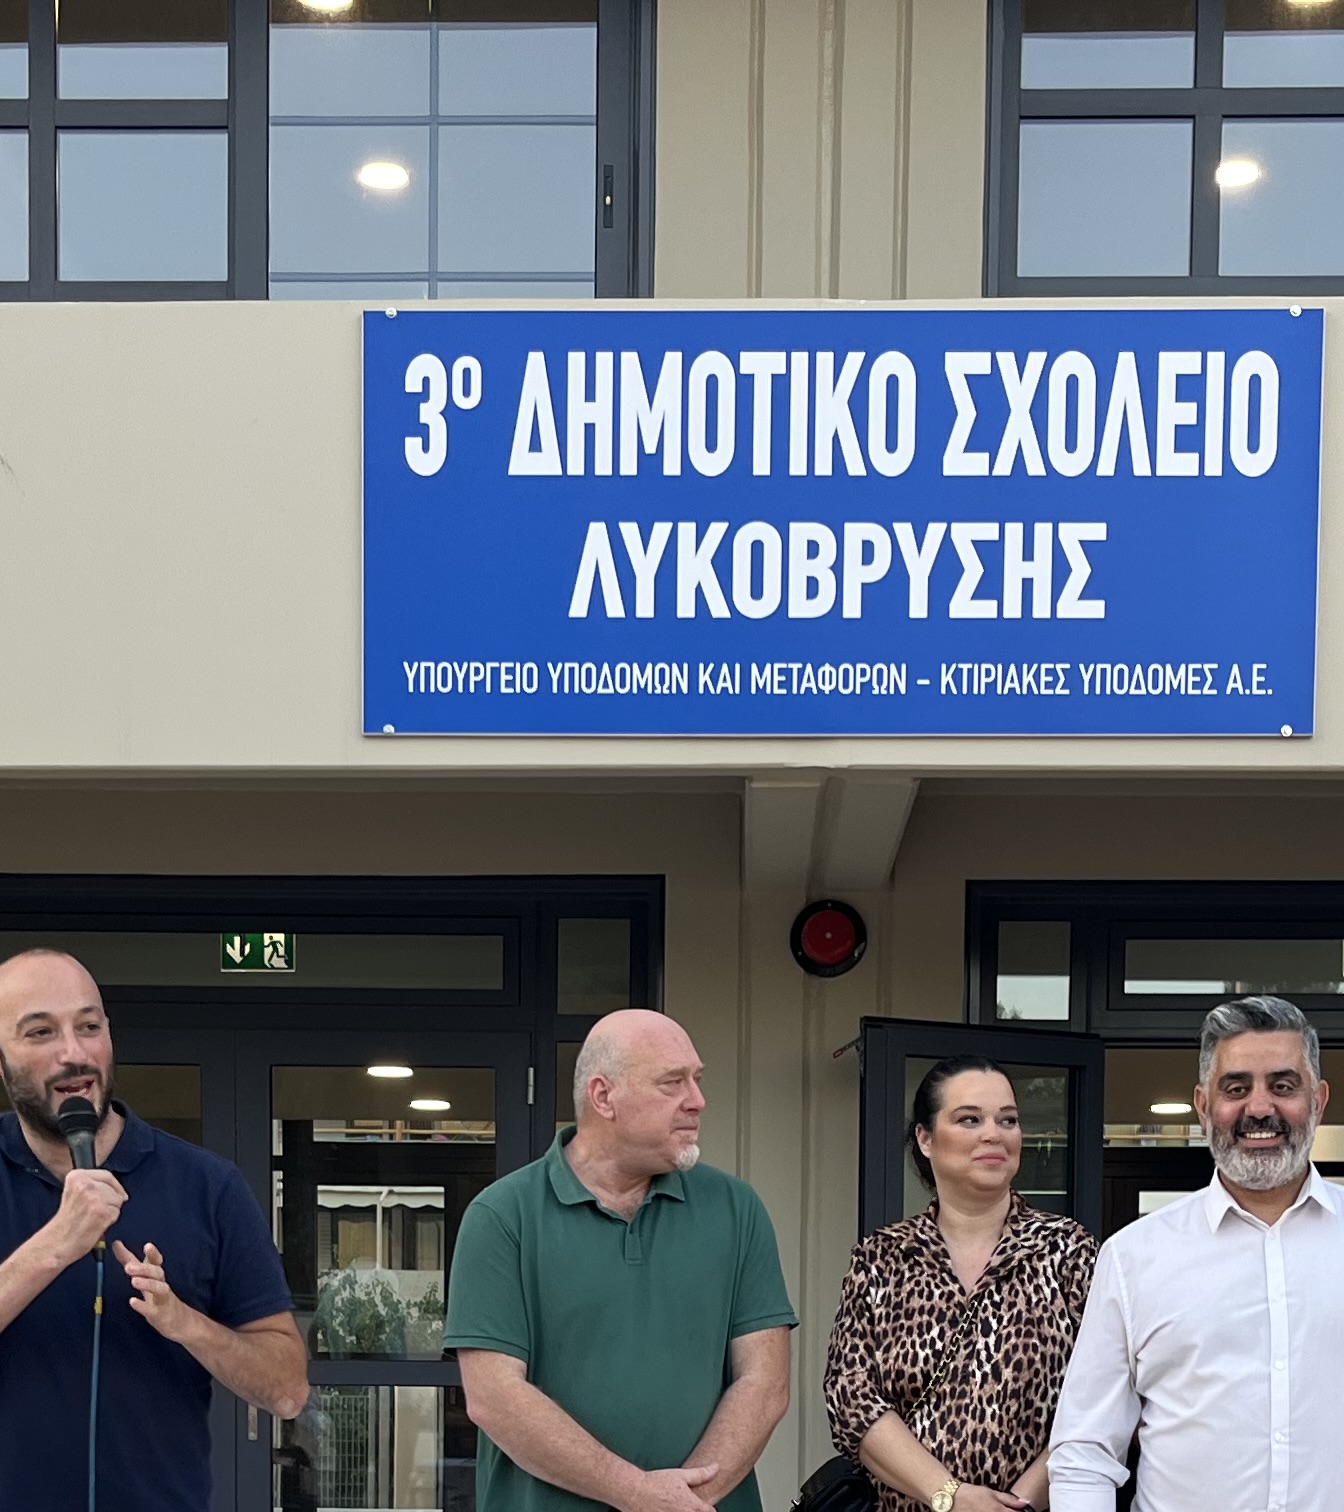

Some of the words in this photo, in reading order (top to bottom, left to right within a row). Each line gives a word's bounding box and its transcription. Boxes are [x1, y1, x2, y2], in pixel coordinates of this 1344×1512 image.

[507, 350, 917, 477] ΔΗΜΟΤΙΚΟ
[942, 349, 1280, 478] ΣΧΟΛΕΙΟ
[567, 521, 1108, 619] ΛΥΚΟΒΡΥΣΗΣ
[402, 661, 539, 694] ΥΠΟΥΡΓΕΙΟ
[547, 662, 689, 695] ΥΠΟΔΟΜΩΝ
[698, 662, 741, 695] ΚΑΙ
[750, 662, 907, 695] ΜΕΤΑΦΟΡΩΝ
[940, 662, 1071, 695] ΚΤΙΡΙΑΚΕΣ
[1078, 663, 1219, 695] ΥΠΟΔΟΜΕΣ
[1225, 663, 1273, 695] Α.Ε.
